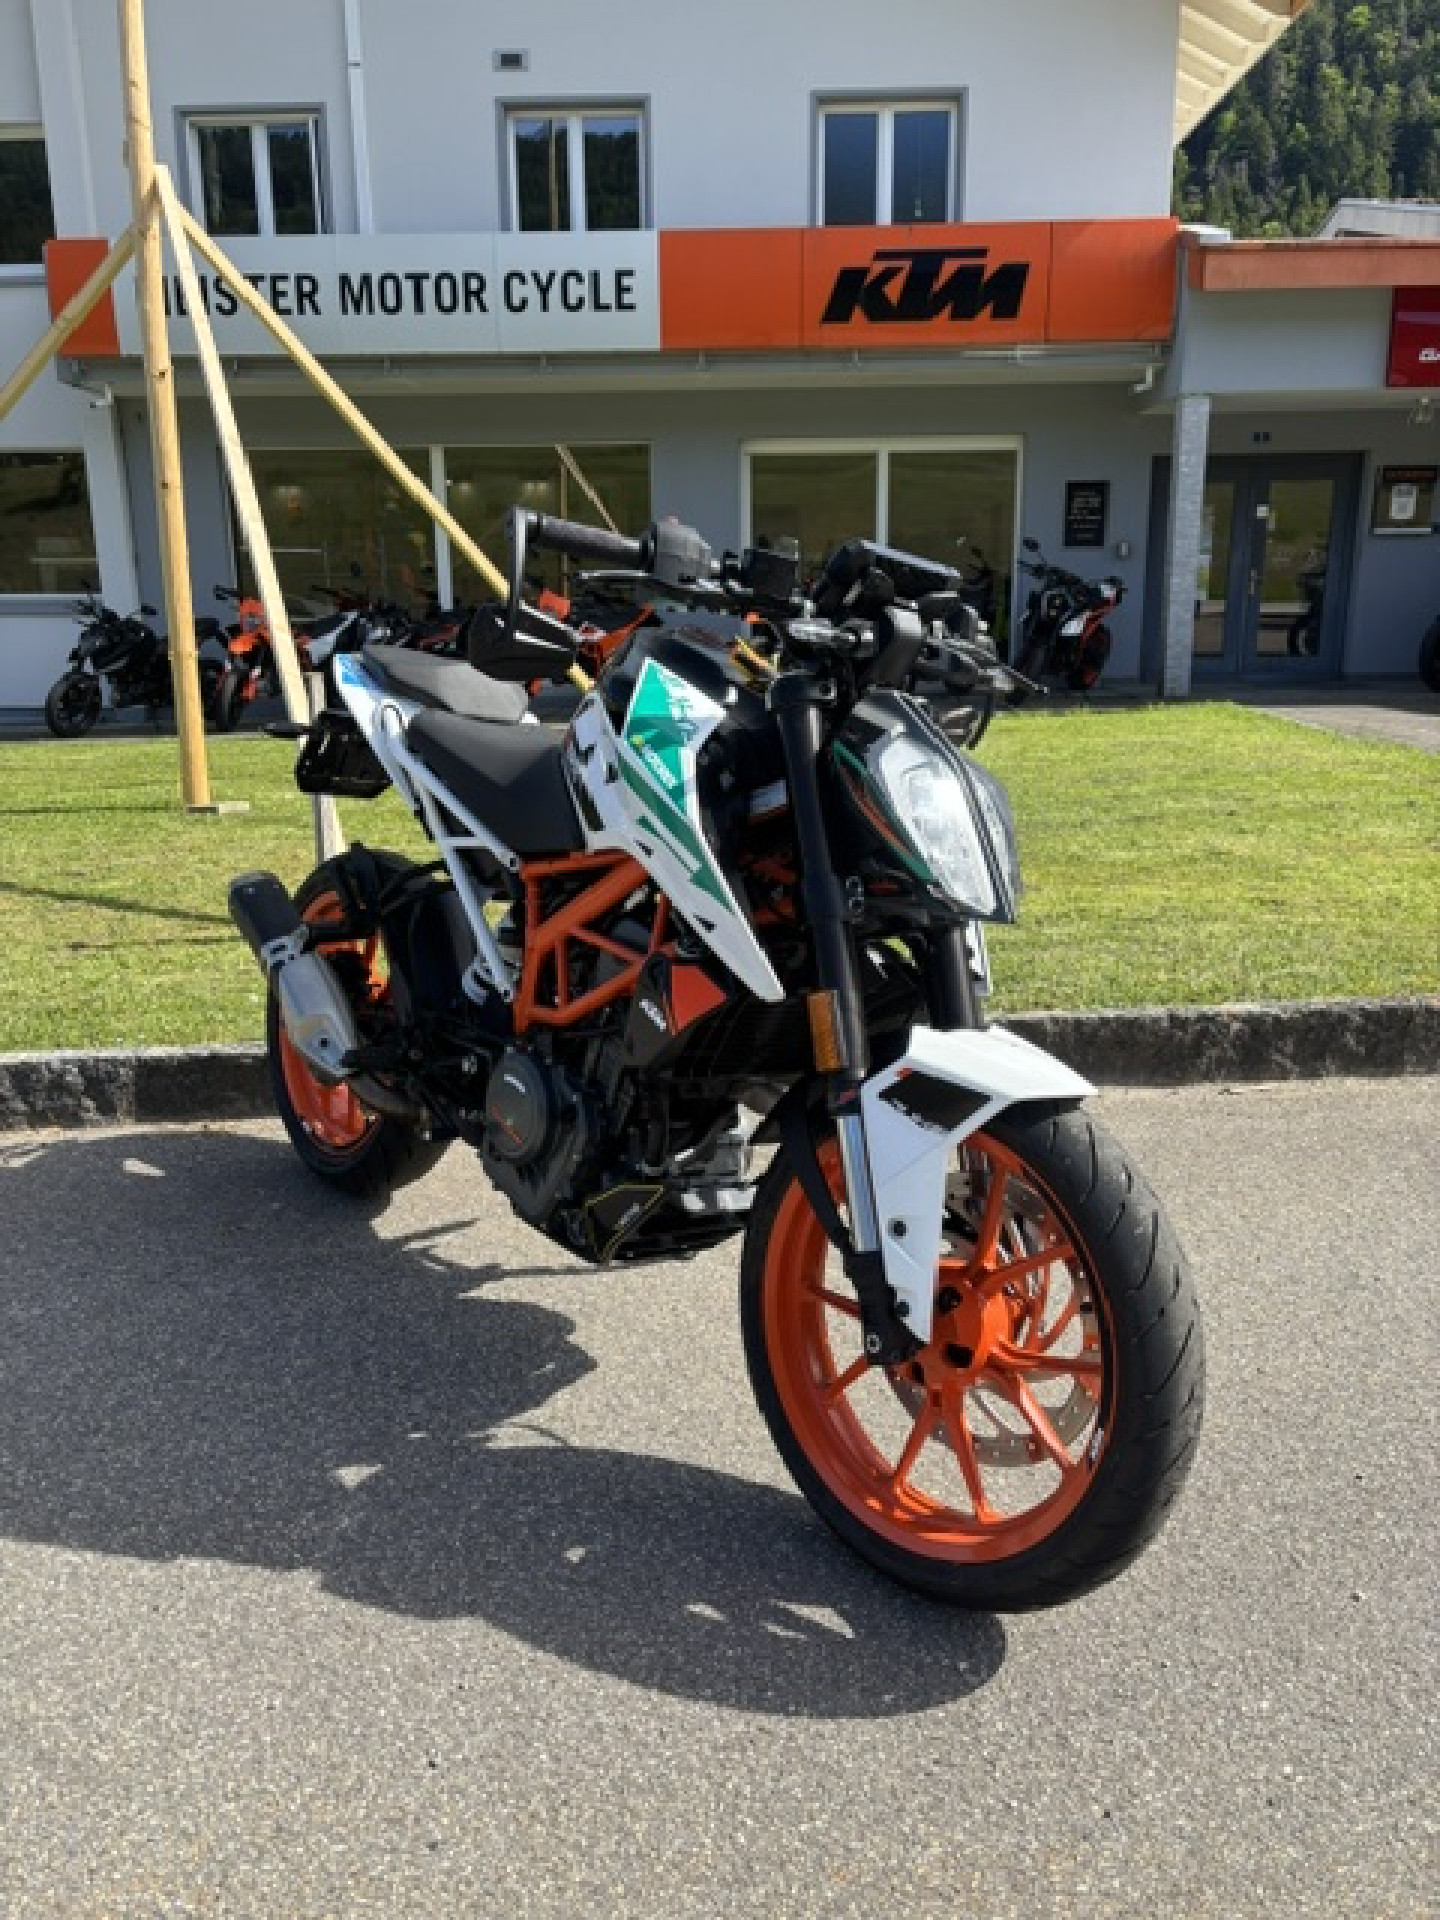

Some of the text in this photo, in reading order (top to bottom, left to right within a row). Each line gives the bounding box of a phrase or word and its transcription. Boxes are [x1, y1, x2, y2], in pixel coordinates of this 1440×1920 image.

[162, 269, 637, 316] EISTER MOTOR CYCLE
[821, 247, 1030, 324] KTM
